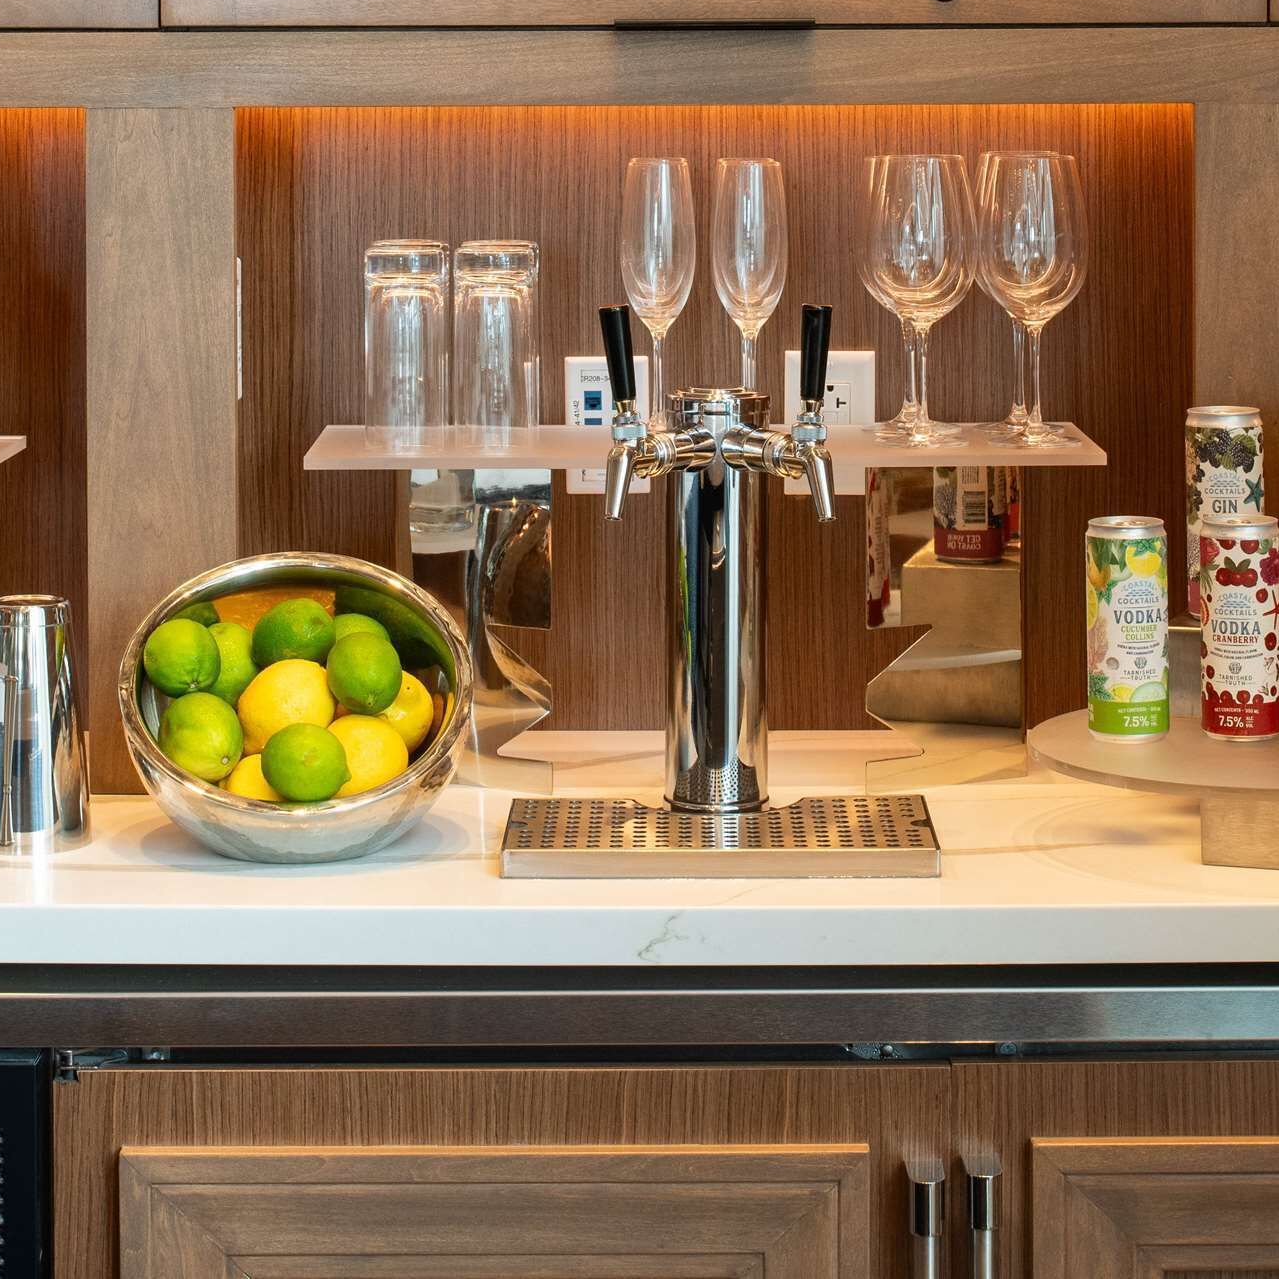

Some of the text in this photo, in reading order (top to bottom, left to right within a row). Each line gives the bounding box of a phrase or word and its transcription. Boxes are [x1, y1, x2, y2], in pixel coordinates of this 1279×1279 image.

[1208, 473, 1241, 482] COASTAL
[1204, 487, 1246, 495] COCKTAILS
[1212, 499, 1238, 513] GIN
[1122, 580, 1155, 592] COASTAL
[1117, 596, 1160, 605] COCKTAILS
[1217, 592, 1252, 603] COASTAL
[1114, 609, 1162, 625] VODKA
[1214, 608, 1258, 616] COCKTAILS
[1120, 624, 1158, 633] CUCUMBER
[1211, 619, 1261, 635] VODKA
[1125, 632, 1154, 641] COLLINS
[1212, 634, 1260, 644] CRANBERRY
[1123, 715, 1150, 728] 7.5%
[1218, 715, 1244, 728] 7.5%
